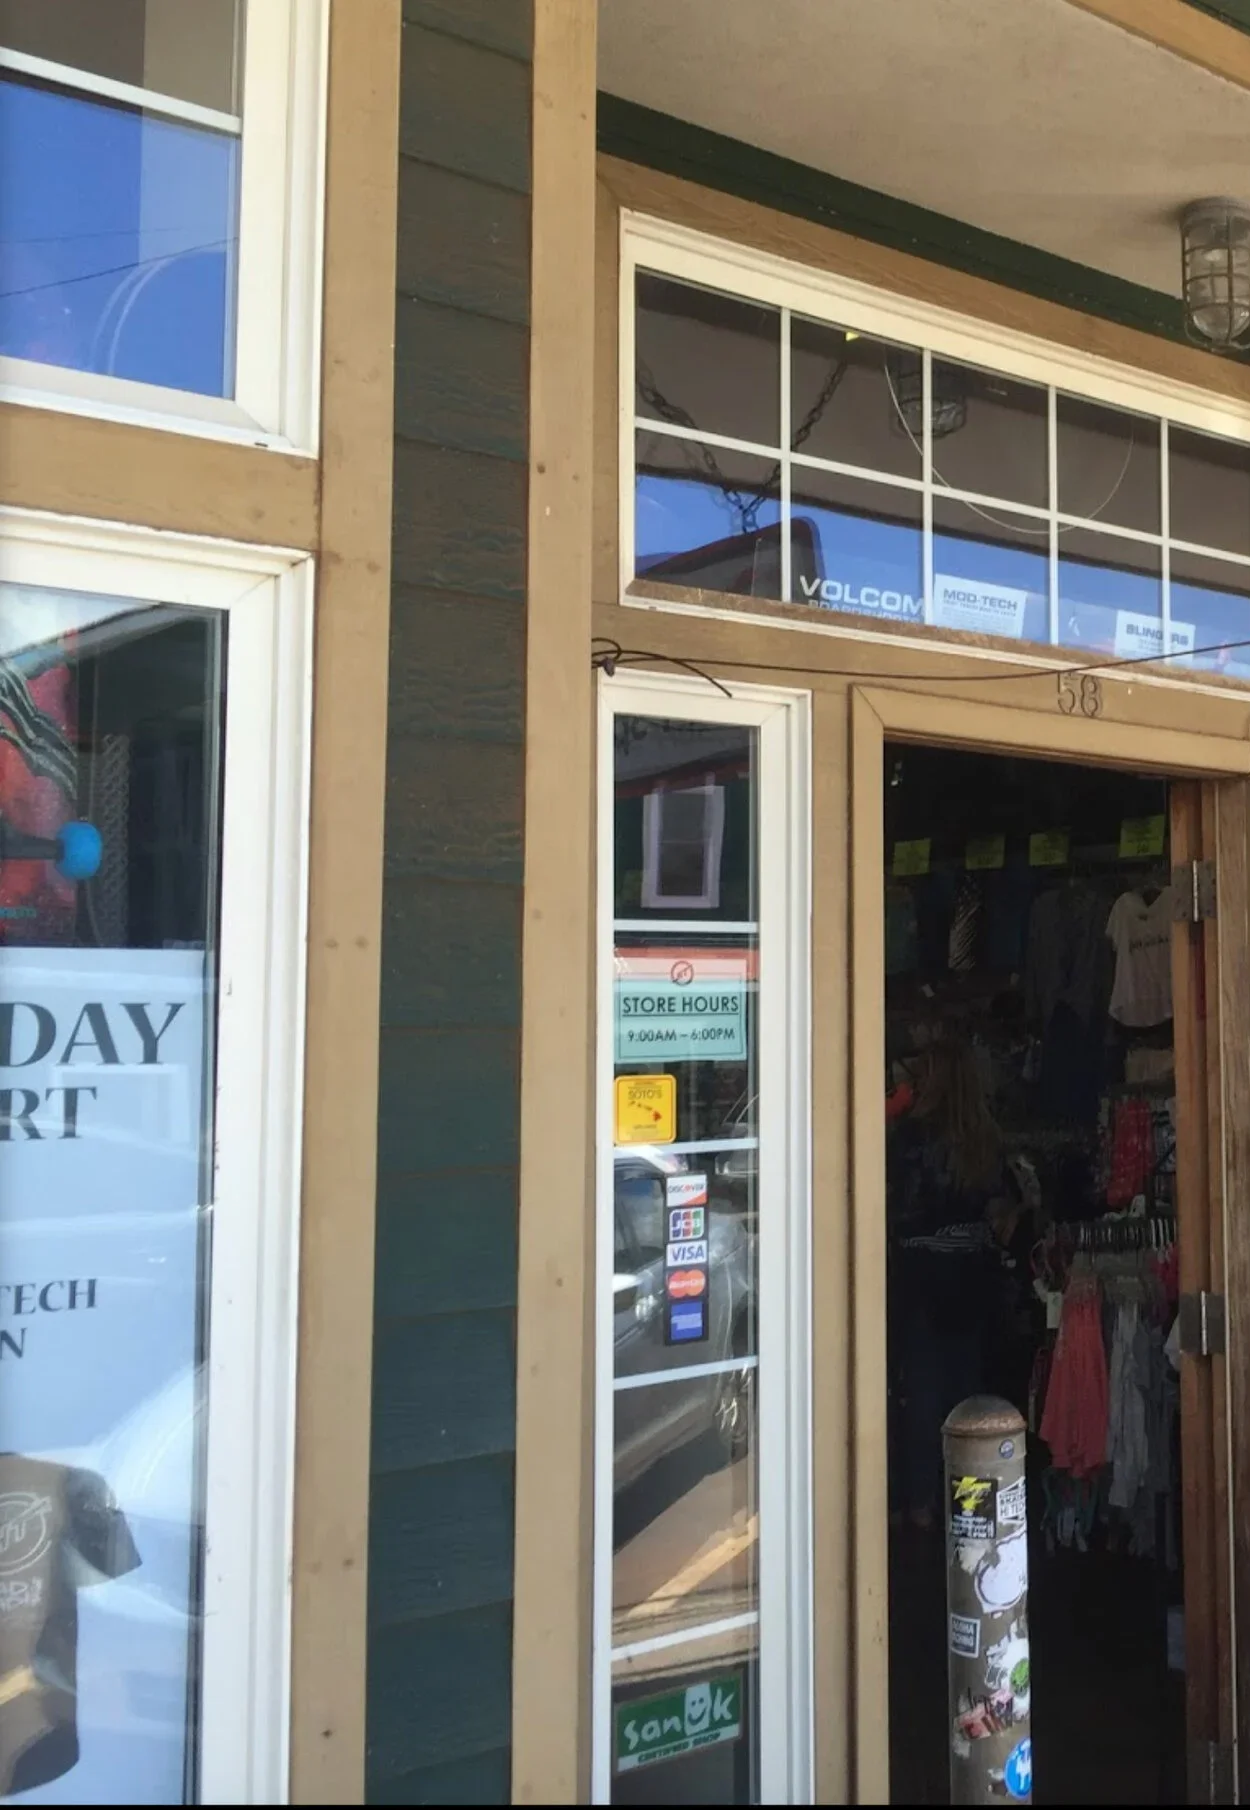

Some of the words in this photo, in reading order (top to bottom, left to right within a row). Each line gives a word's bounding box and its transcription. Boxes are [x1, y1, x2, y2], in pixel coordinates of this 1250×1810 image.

[800, 575, 924, 616] VOLCOM
[1126, 623, 1189, 646] BLINGRS
[1057, 671, 1099, 717] 58
[623, 996, 676, 1013] STORE
[682, 996, 739, 1012] HOURS
[0, 1002, 187, 1067] DAY
[628, 1029, 677, 1042] 9:00AM
[690, 1028, 735, 1041] 6:00PM
[0, 1086, 98, 1141] RT
[672, 1244, 705, 1262] VISA
